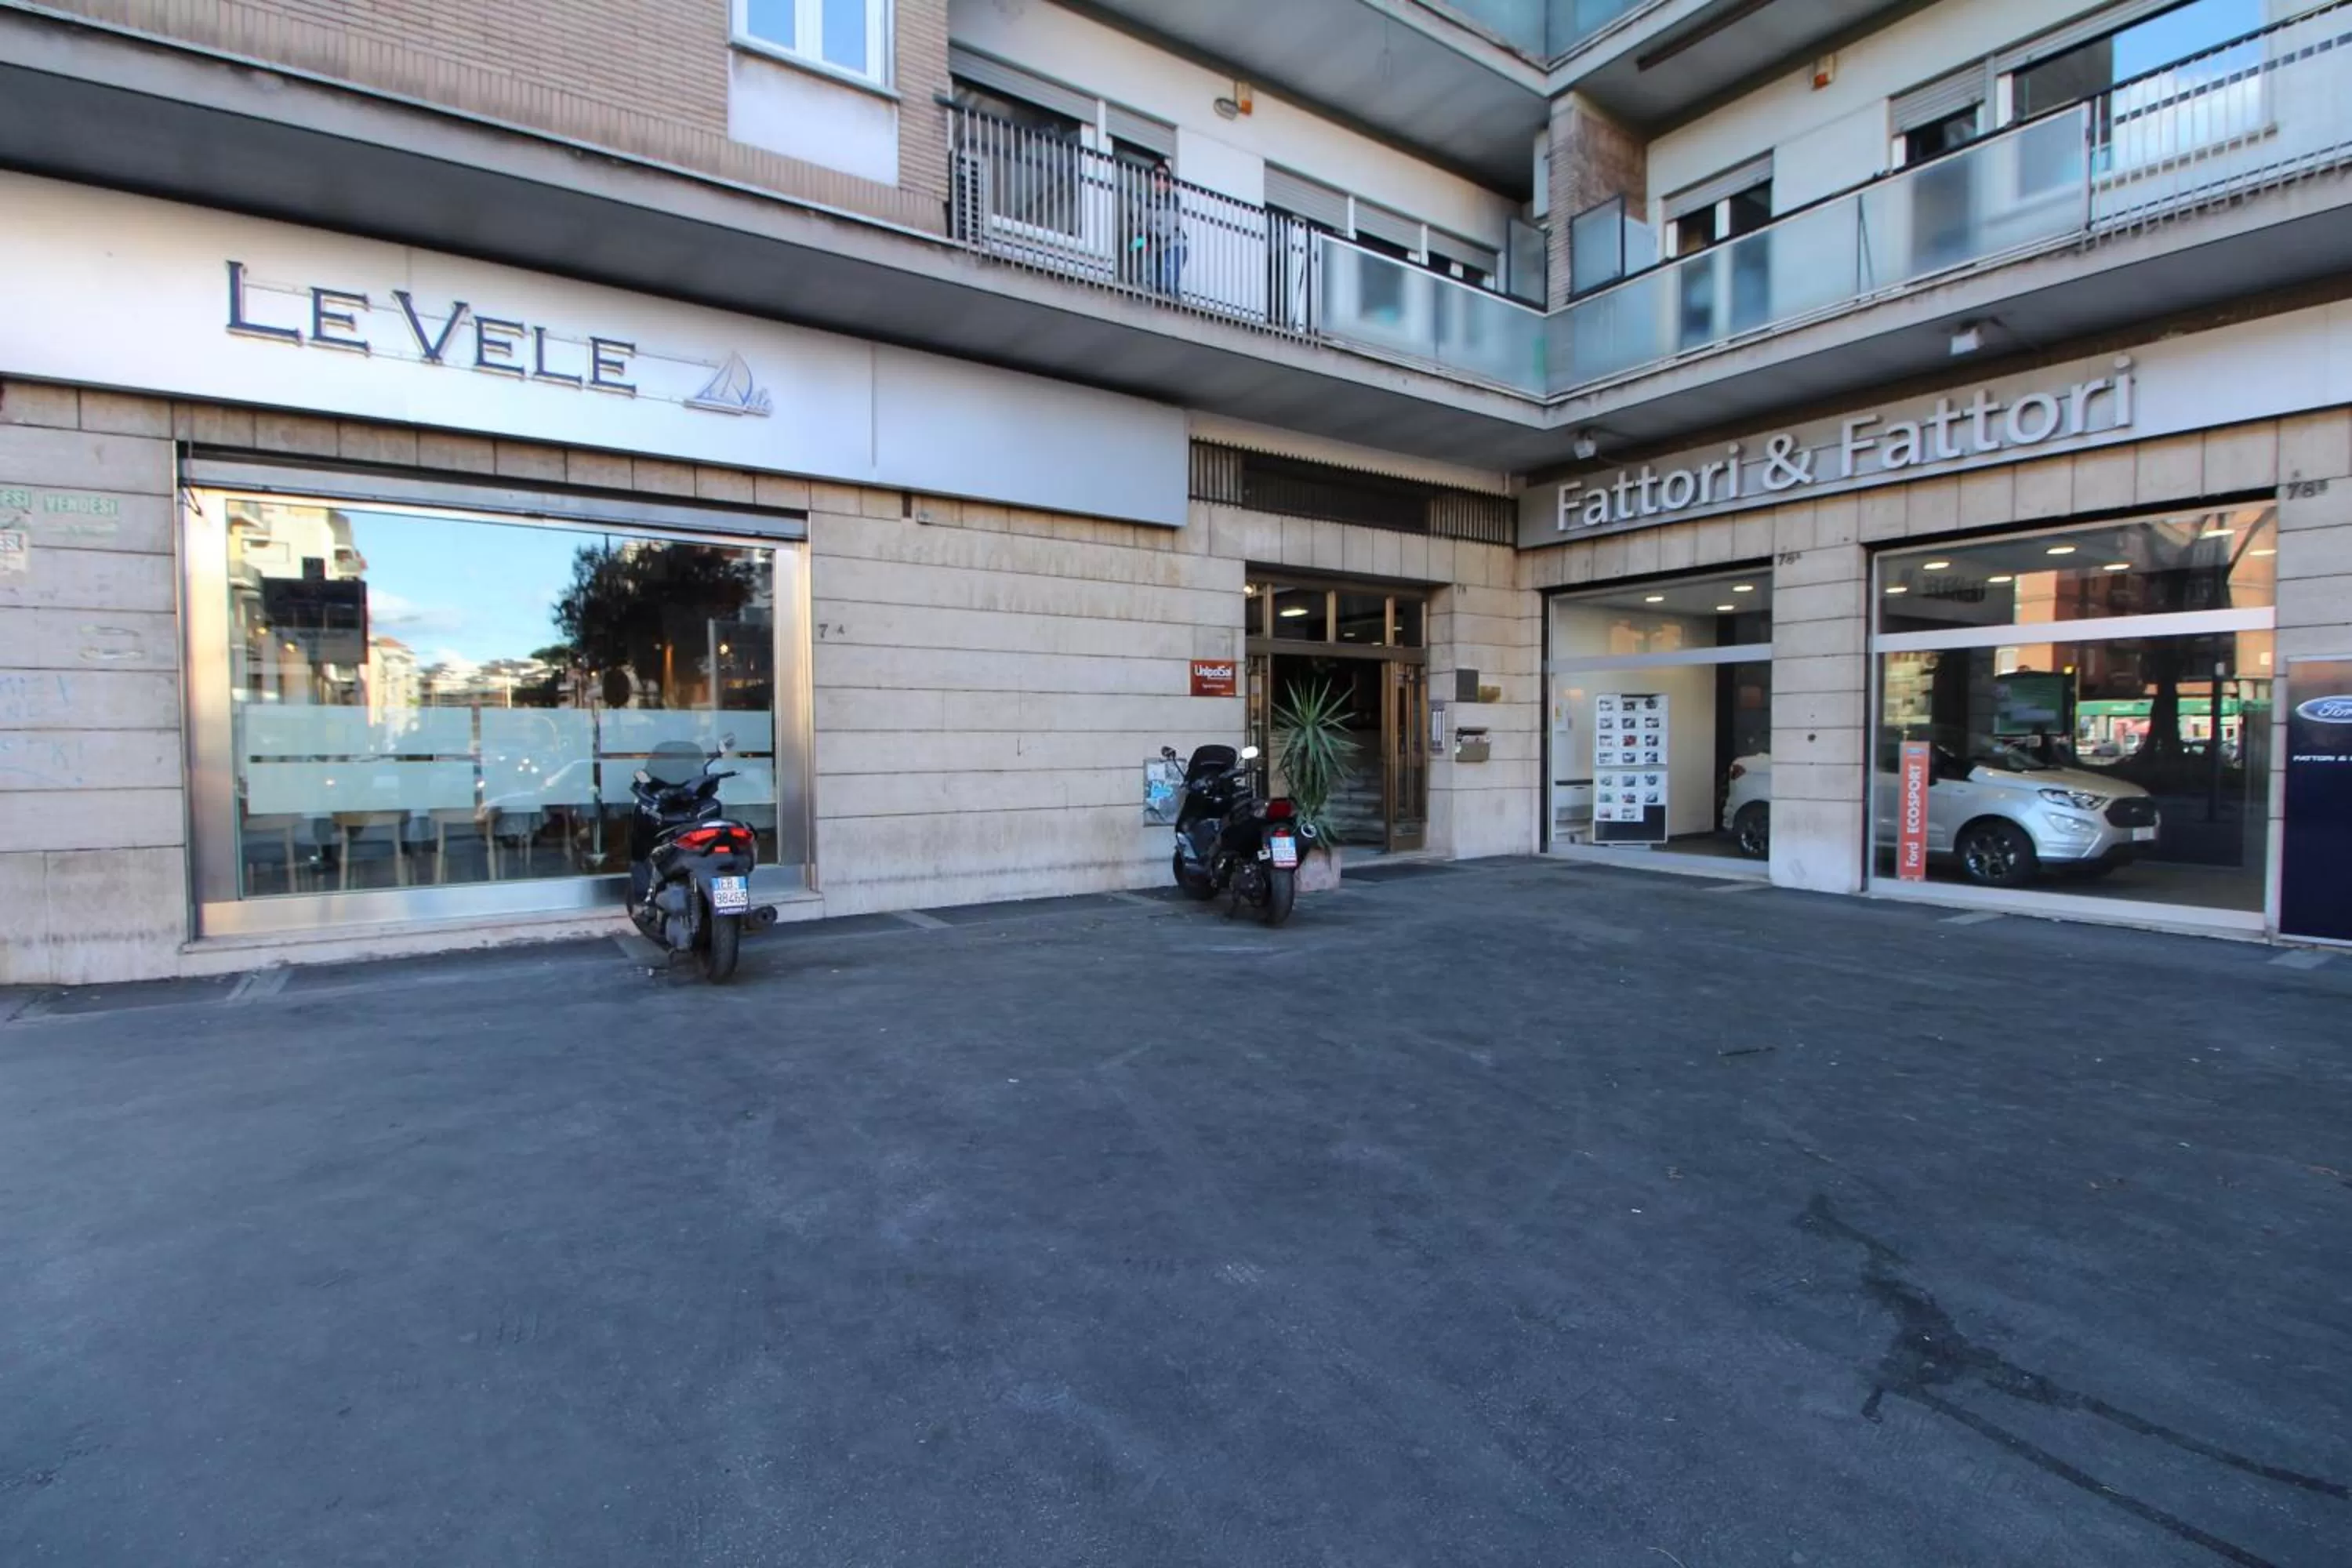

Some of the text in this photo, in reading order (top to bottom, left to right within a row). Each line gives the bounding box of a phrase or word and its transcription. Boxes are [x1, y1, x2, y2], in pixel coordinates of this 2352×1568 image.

[391, 290, 637, 398] VELE
[1557, 354, 2134, 531] Fattori & Fattori
[1907, 764, 1922, 833] ECOSPORT
[1905, 841, 1919, 867] Ford
